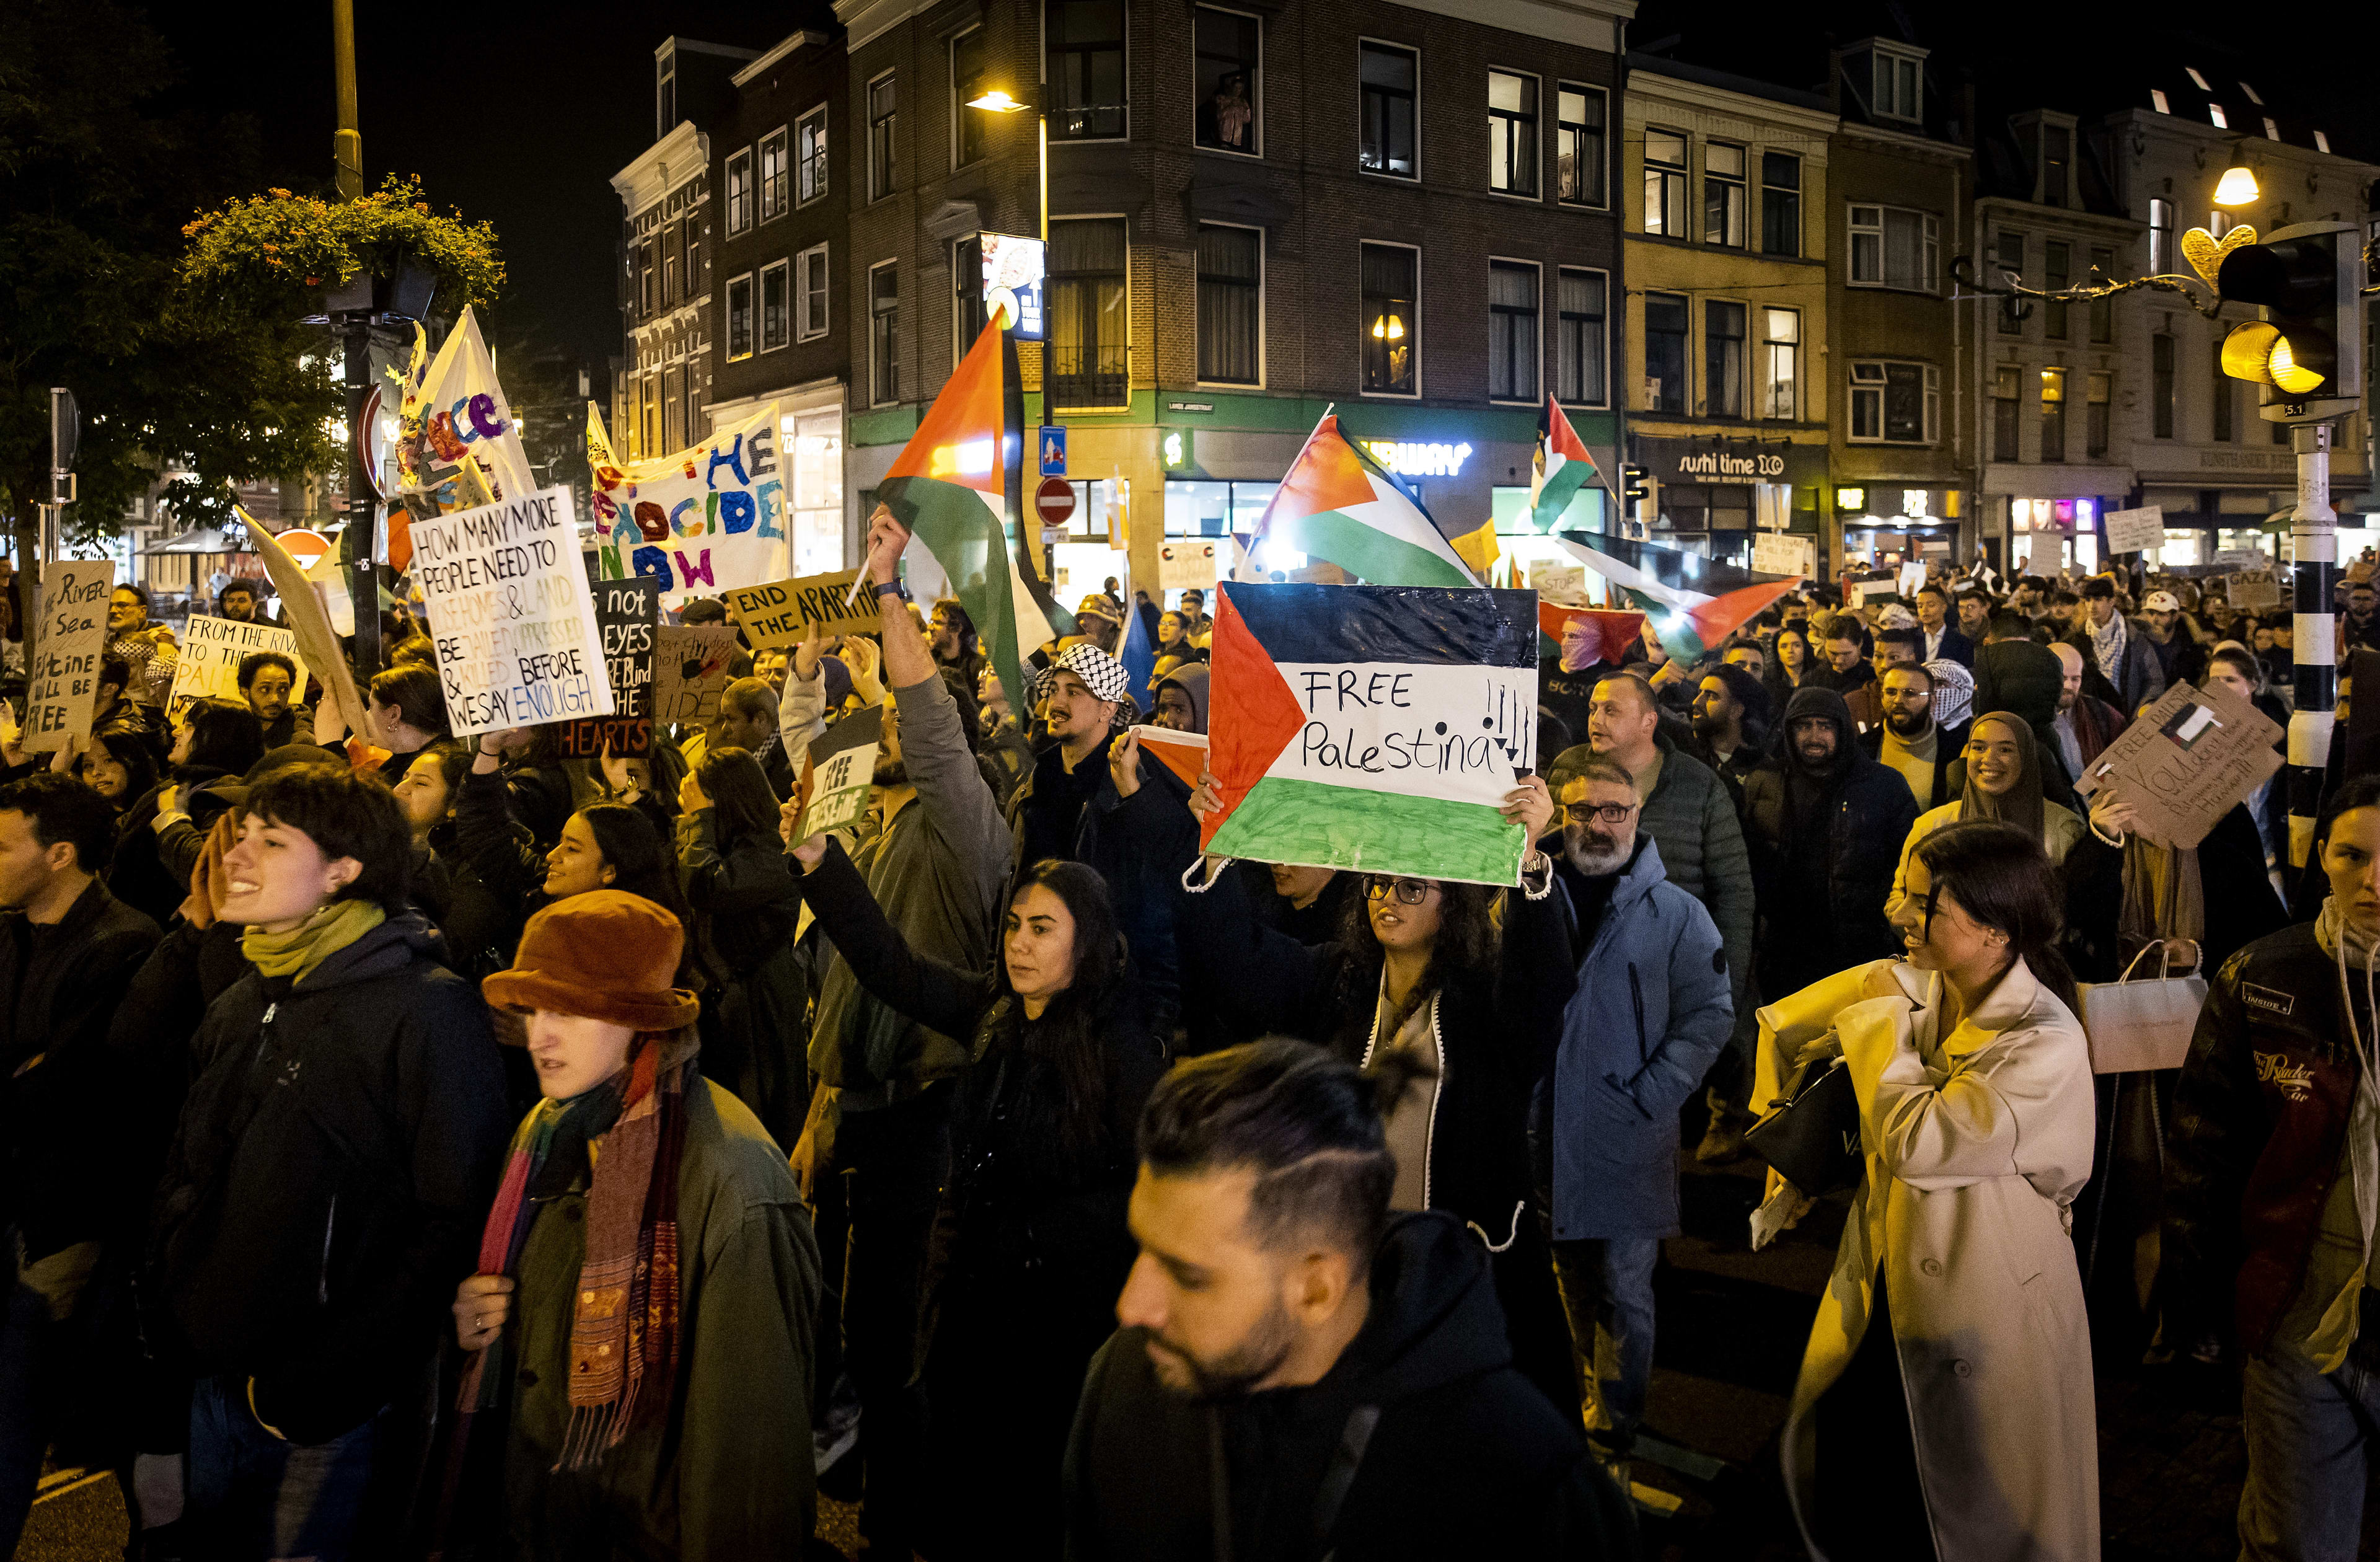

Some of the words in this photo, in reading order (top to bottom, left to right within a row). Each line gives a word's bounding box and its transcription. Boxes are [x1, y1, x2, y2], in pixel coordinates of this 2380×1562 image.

[1719, 452, 1755, 475] time
[415, 523, 459, 564] HOW
[462, 506, 510, 552] MANY
[511, 496, 560, 538] MORE
[422, 558, 481, 597] PEOPLE
[481, 545, 531, 585] NEED
[528, 539, 557, 569] TO
[1545, 577, 1576, 590] STOP
[507, 585, 524, 620] &
[607, 588, 648, 618] not
[736, 586, 787, 614] END
[188, 619, 237, 643] FROM
[242, 626, 268, 648] THE
[603, 623, 652, 656] EYES
[749, 611, 800, 637] THE
[187, 642, 207, 661] TO
[438, 637, 465, 663] BE
[72, 679, 92, 697] BE
[444, 668, 462, 700] &
[518, 648, 584, 686] BEFORE
[447, 695, 479, 729] WE
[477, 688, 511, 725] SAY
[513, 673, 594, 721] ENOUGH
[1300, 669, 1413, 713] FREE
[556, 718, 653, 756] HEARTS
[2112, 727, 2154, 762] FREE
